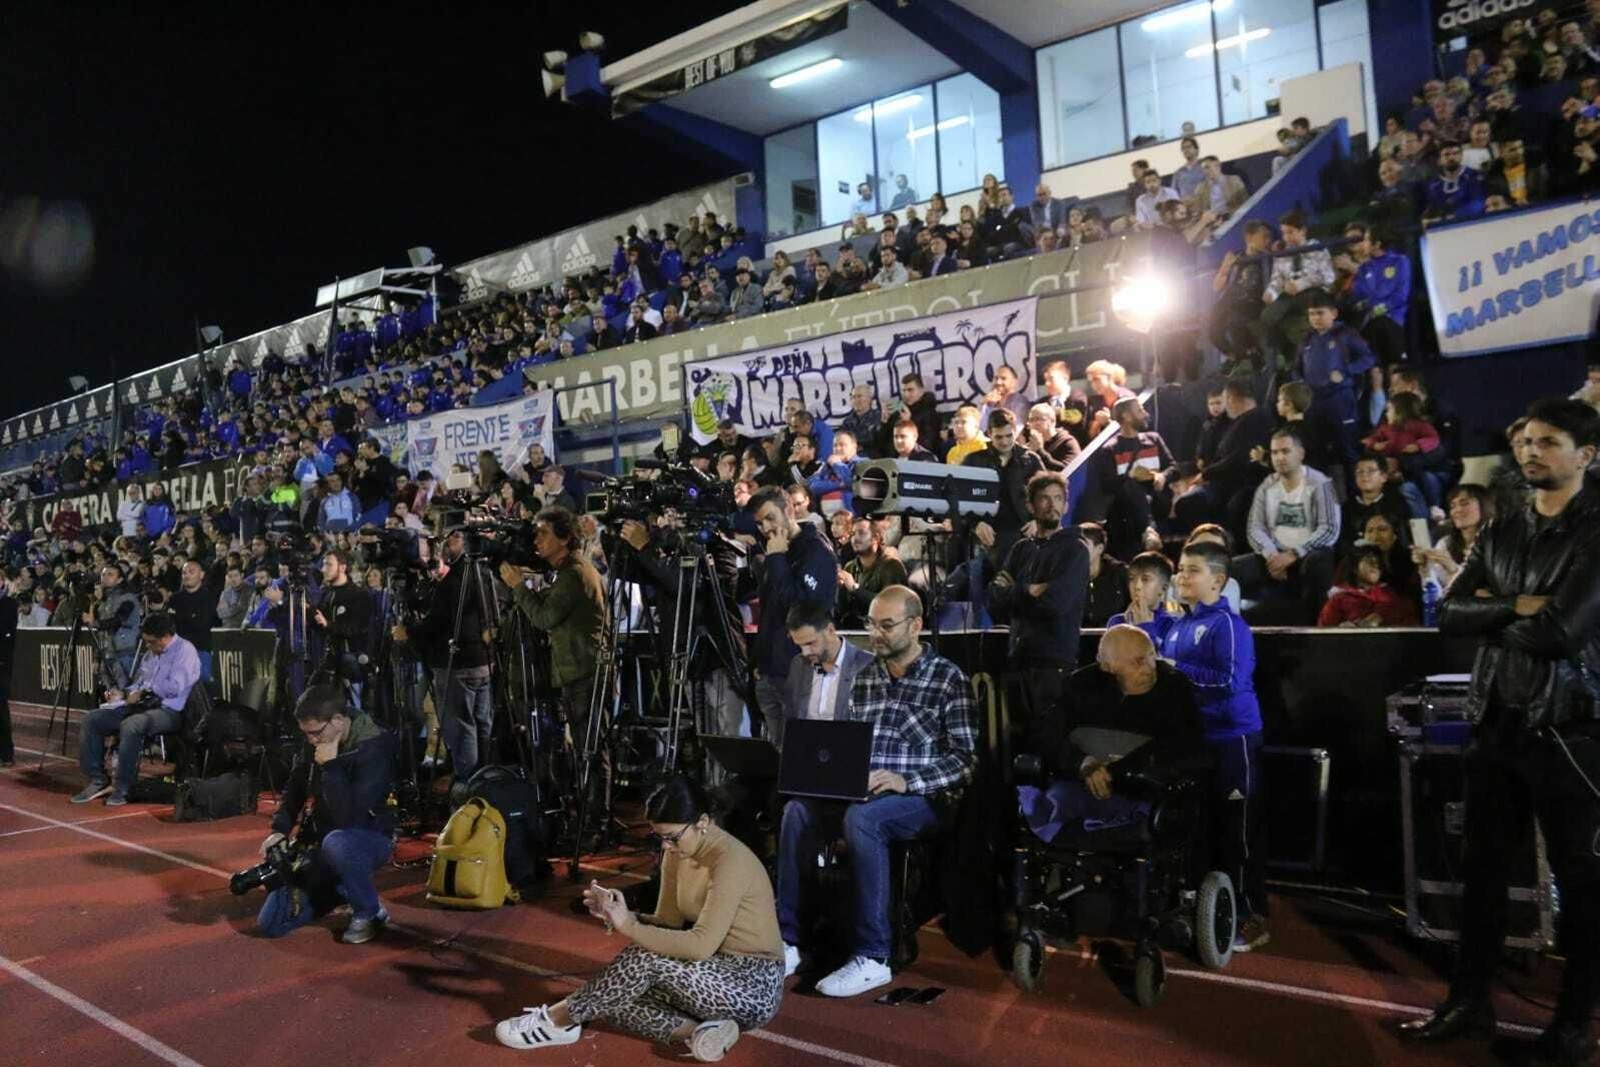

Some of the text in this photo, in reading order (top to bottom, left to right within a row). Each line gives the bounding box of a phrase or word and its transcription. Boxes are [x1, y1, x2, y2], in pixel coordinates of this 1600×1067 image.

[772, 348, 812, 376] PEÑA
[444, 414, 510, 451] FRENTE
[40, 644, 59, 691] BEST
[76, 645, 94, 694] YOU
